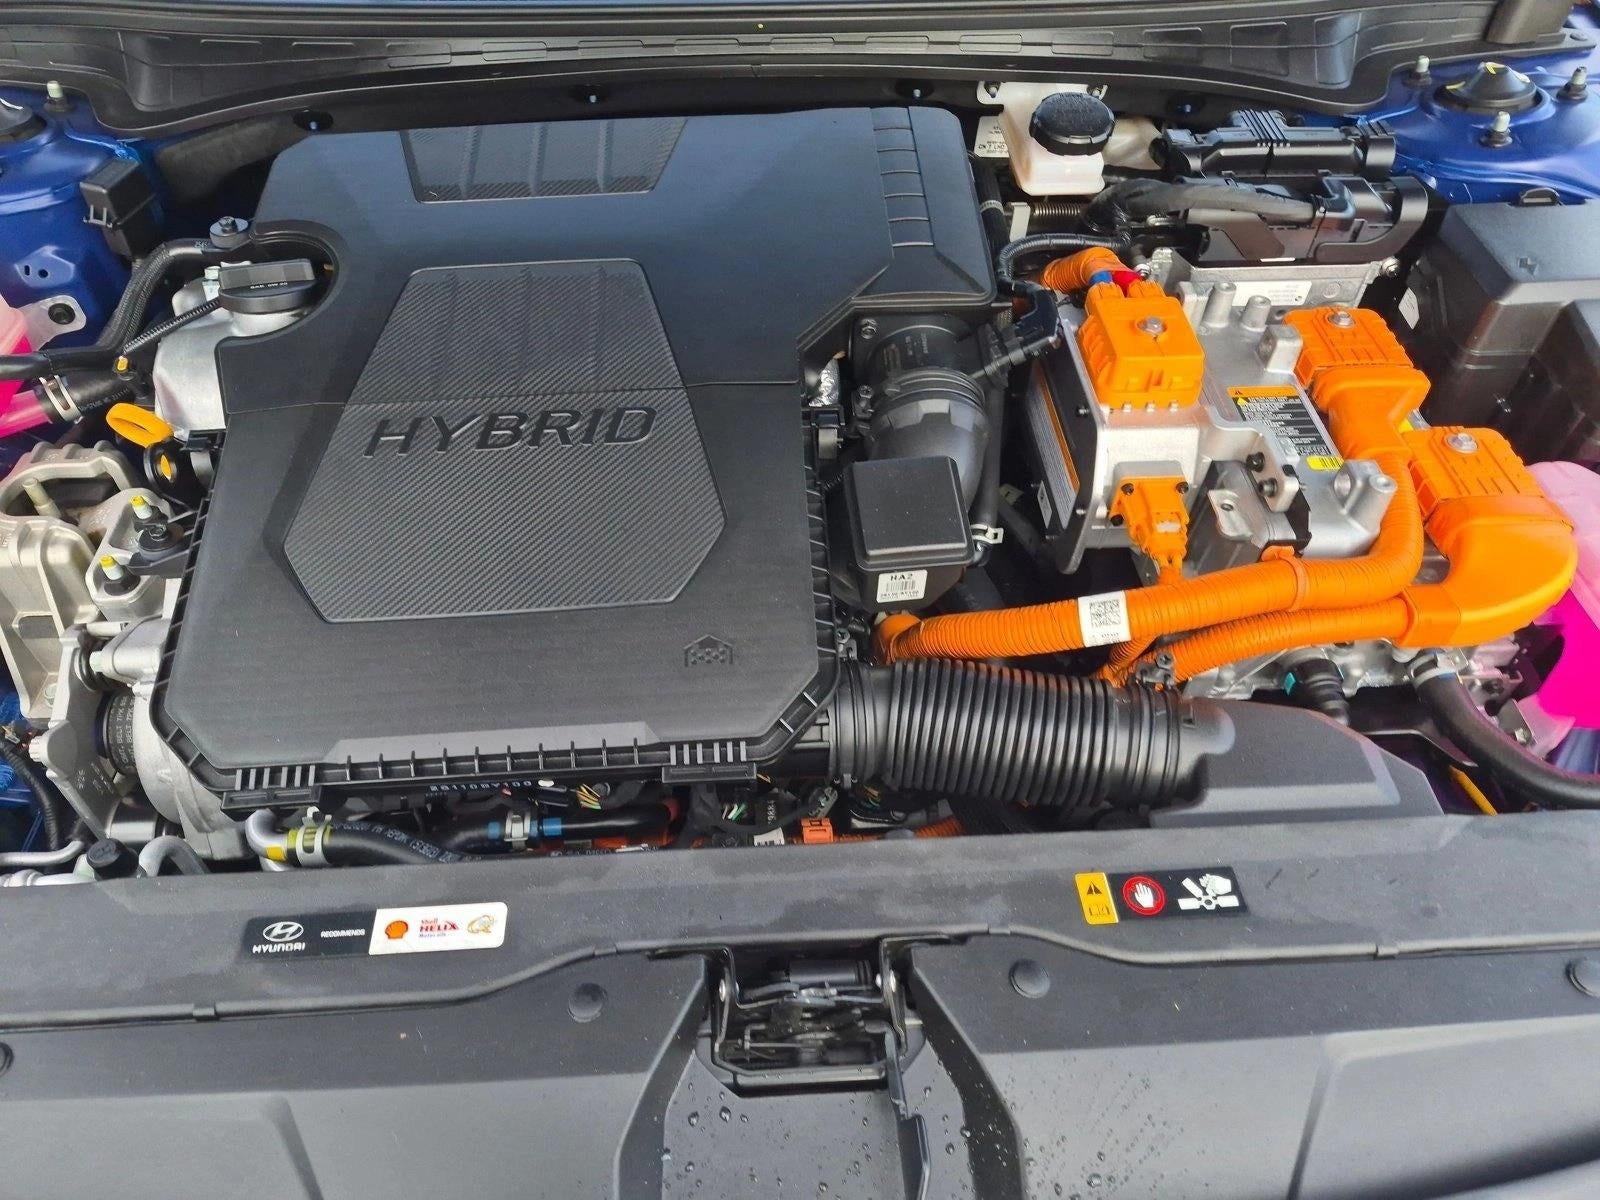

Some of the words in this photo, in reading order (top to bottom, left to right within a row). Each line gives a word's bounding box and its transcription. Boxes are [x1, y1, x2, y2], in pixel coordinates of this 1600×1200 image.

[362, 406, 657, 458] HYBRID
[419, 920, 460, 933] HELIX
[320, 928, 366, 938] RECOMMENDS
[252, 942, 306, 954] HYUNDAI
